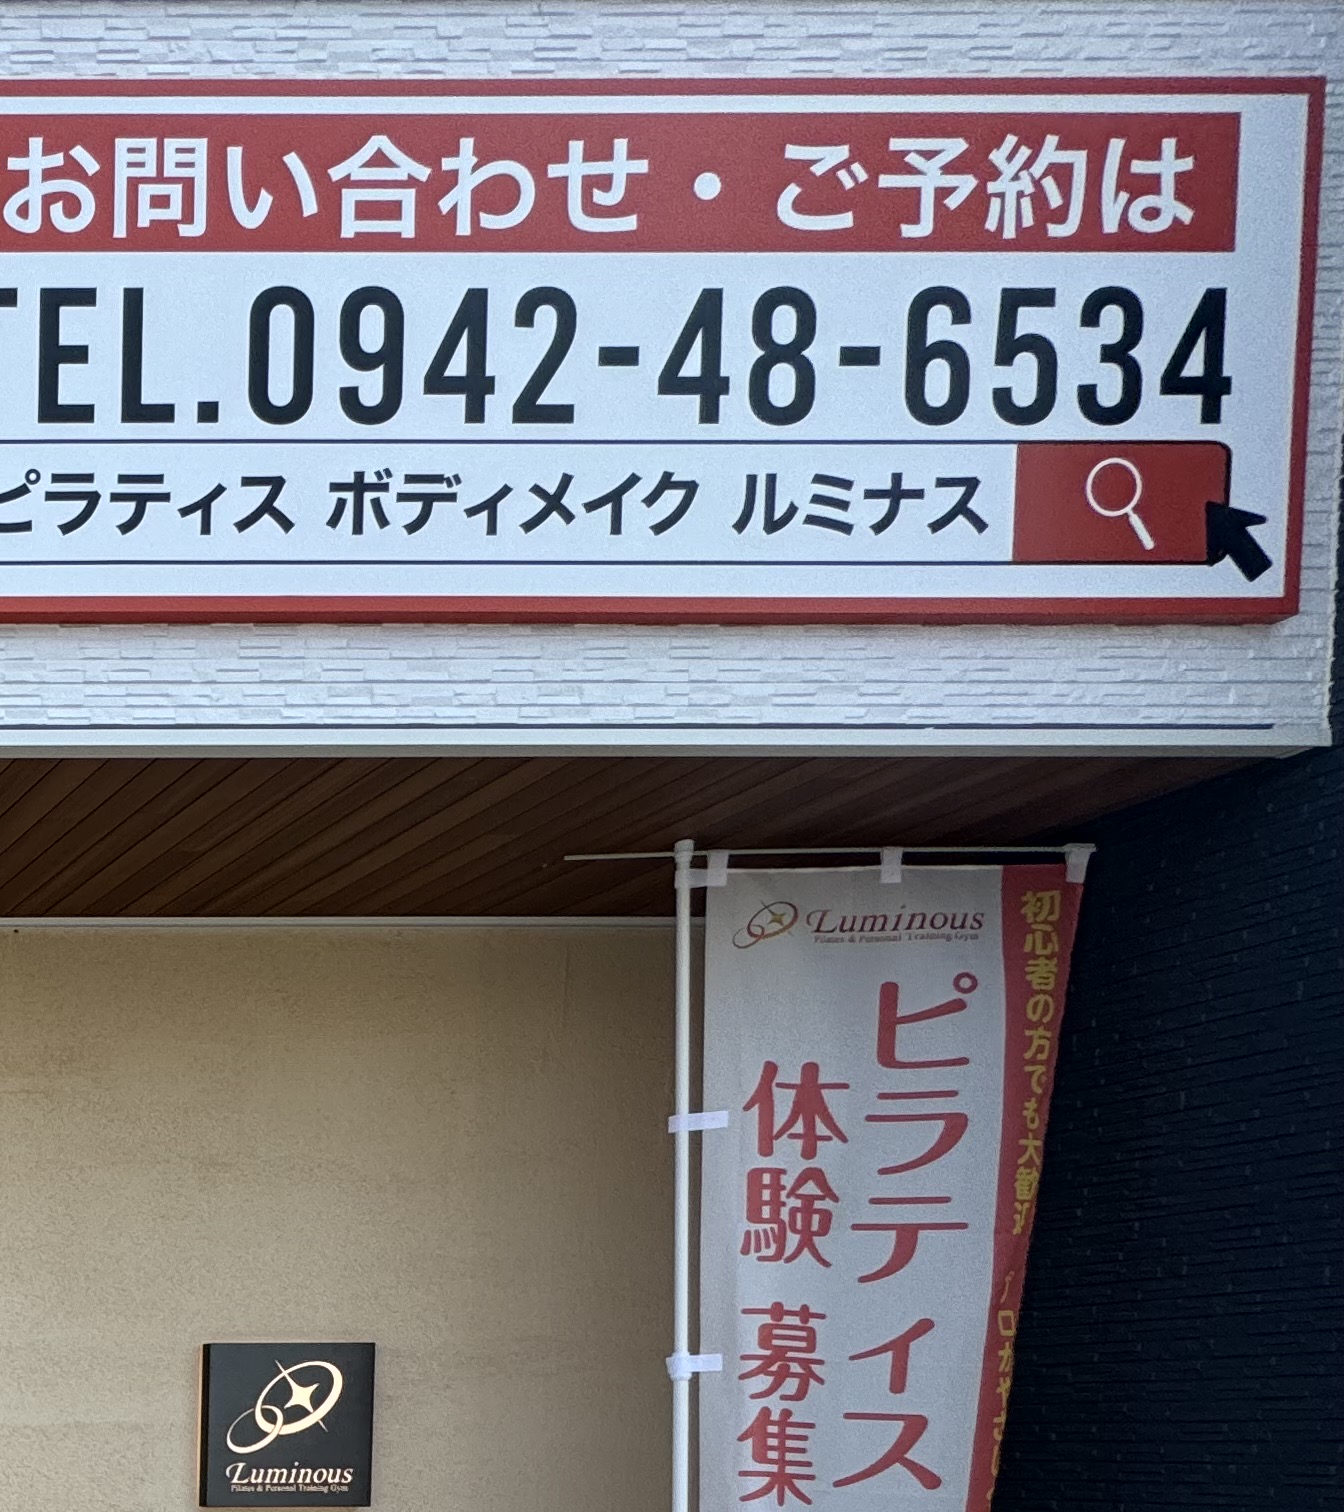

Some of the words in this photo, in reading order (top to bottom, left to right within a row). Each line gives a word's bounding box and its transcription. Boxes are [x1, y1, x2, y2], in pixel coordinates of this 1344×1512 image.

[2, 133, 1196, 239] お問い合わせ・ご予約は
[325, 467, 700, 537] ボディメイク
[731, 470, 990, 537] ルミナス
[805, 904, 985, 934] Luminous
[832, 971, 980, 1490] ピラティス
[225, 1461, 354, 1484] Luminous
